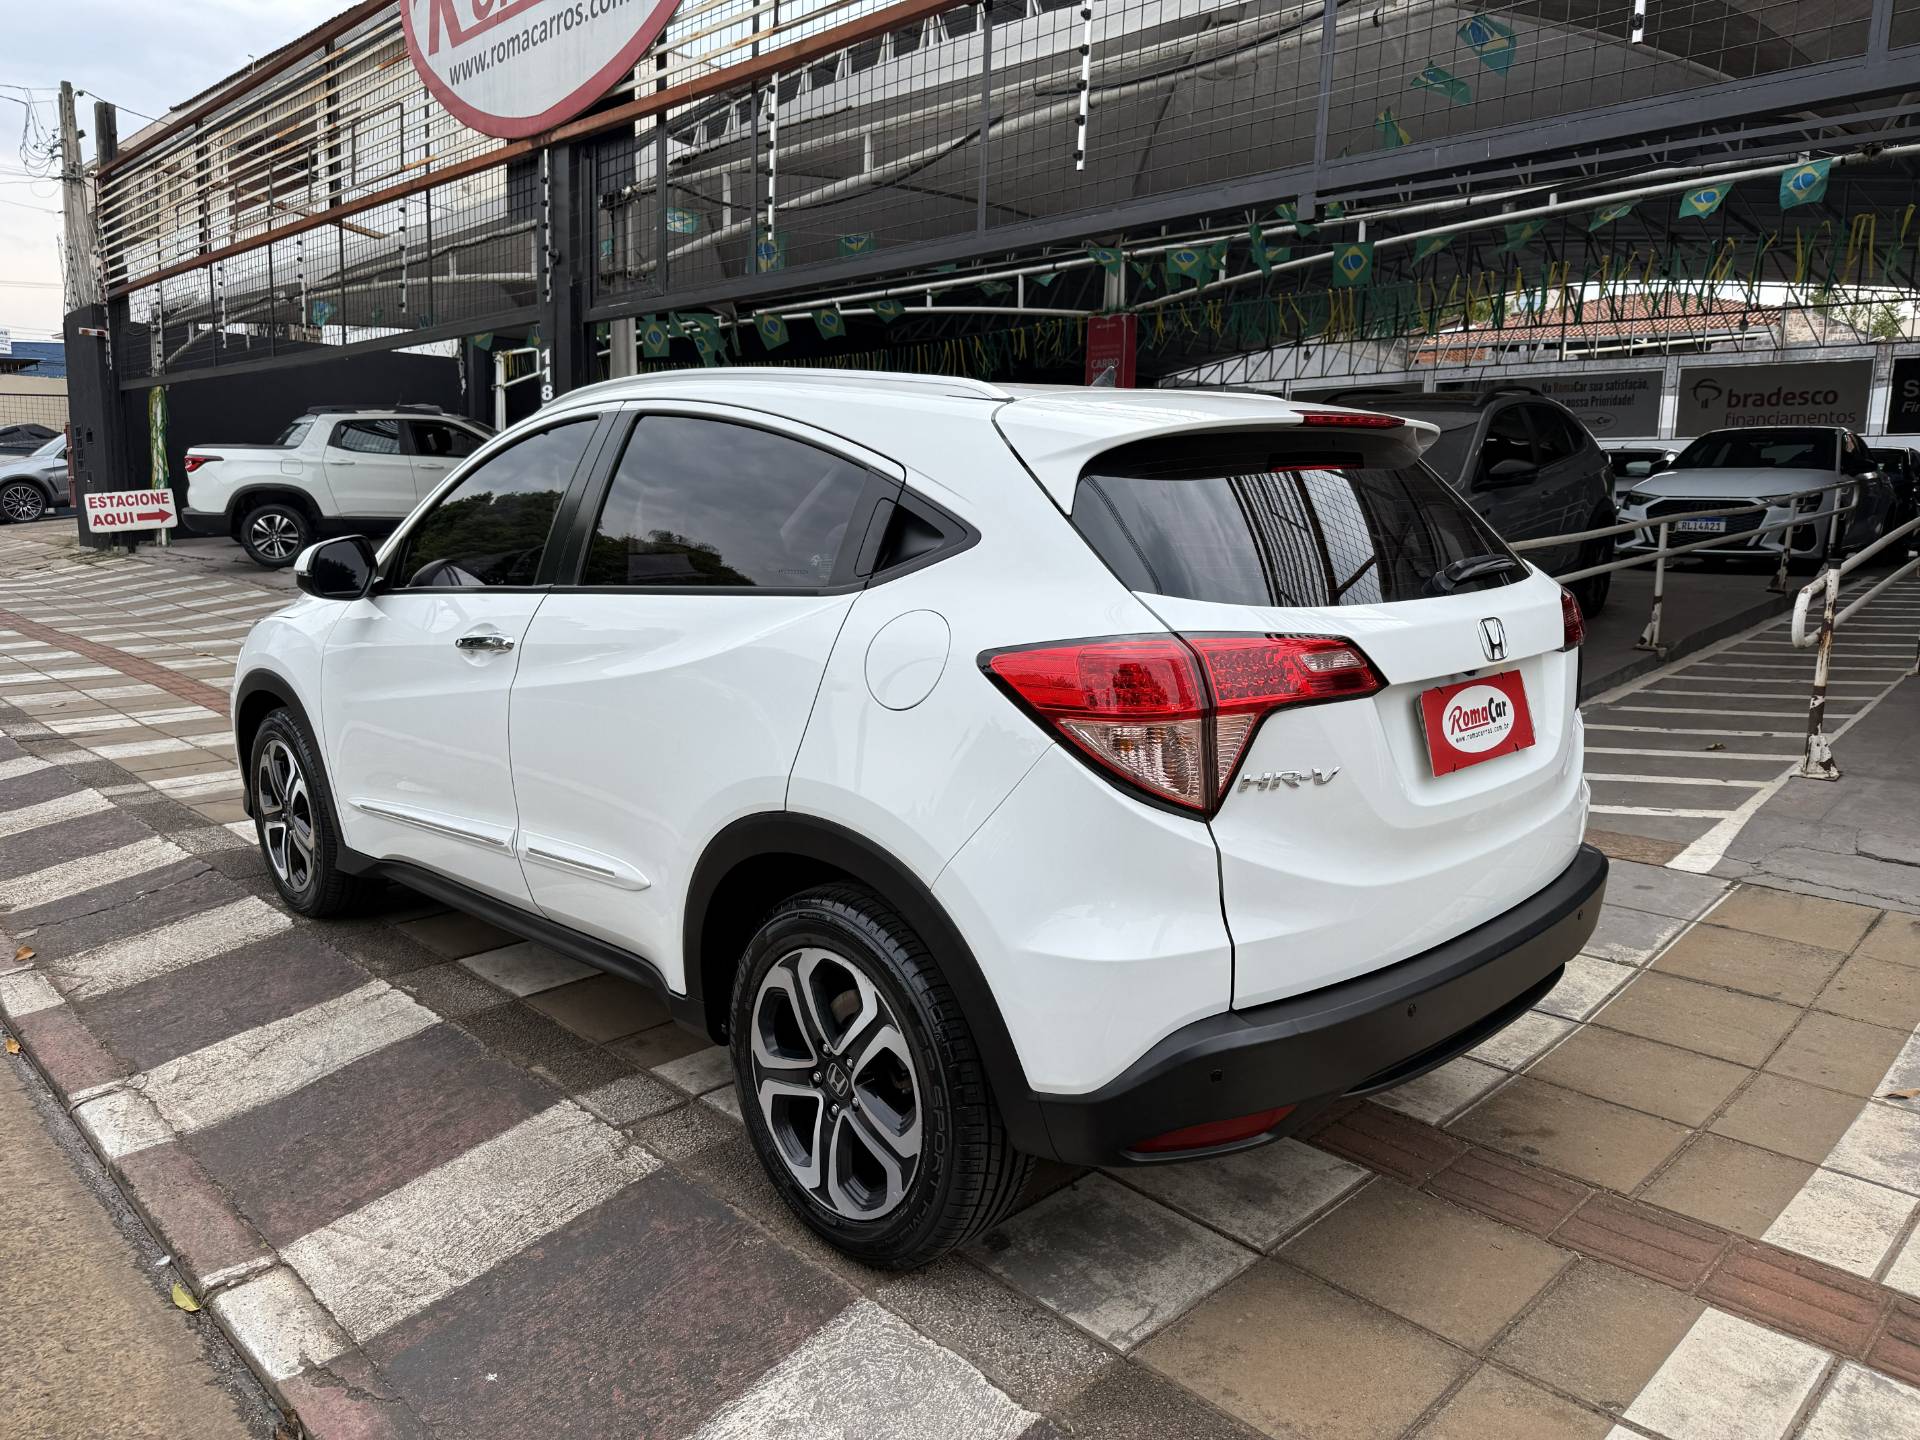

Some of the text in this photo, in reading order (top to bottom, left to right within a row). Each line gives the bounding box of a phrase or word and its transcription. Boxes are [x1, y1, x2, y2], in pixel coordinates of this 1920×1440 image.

[1589, 383, 1603, 392] sua
[1726, 386, 1839, 409] bradesco
[1724, 410, 1856, 427] financiamentos
[88, 492, 170, 509] ESTACIONE
[92, 511, 135, 527] AQUI
[1449, 697, 1507, 735] RomaCar
[1238, 766, 1341, 793] HR-V
